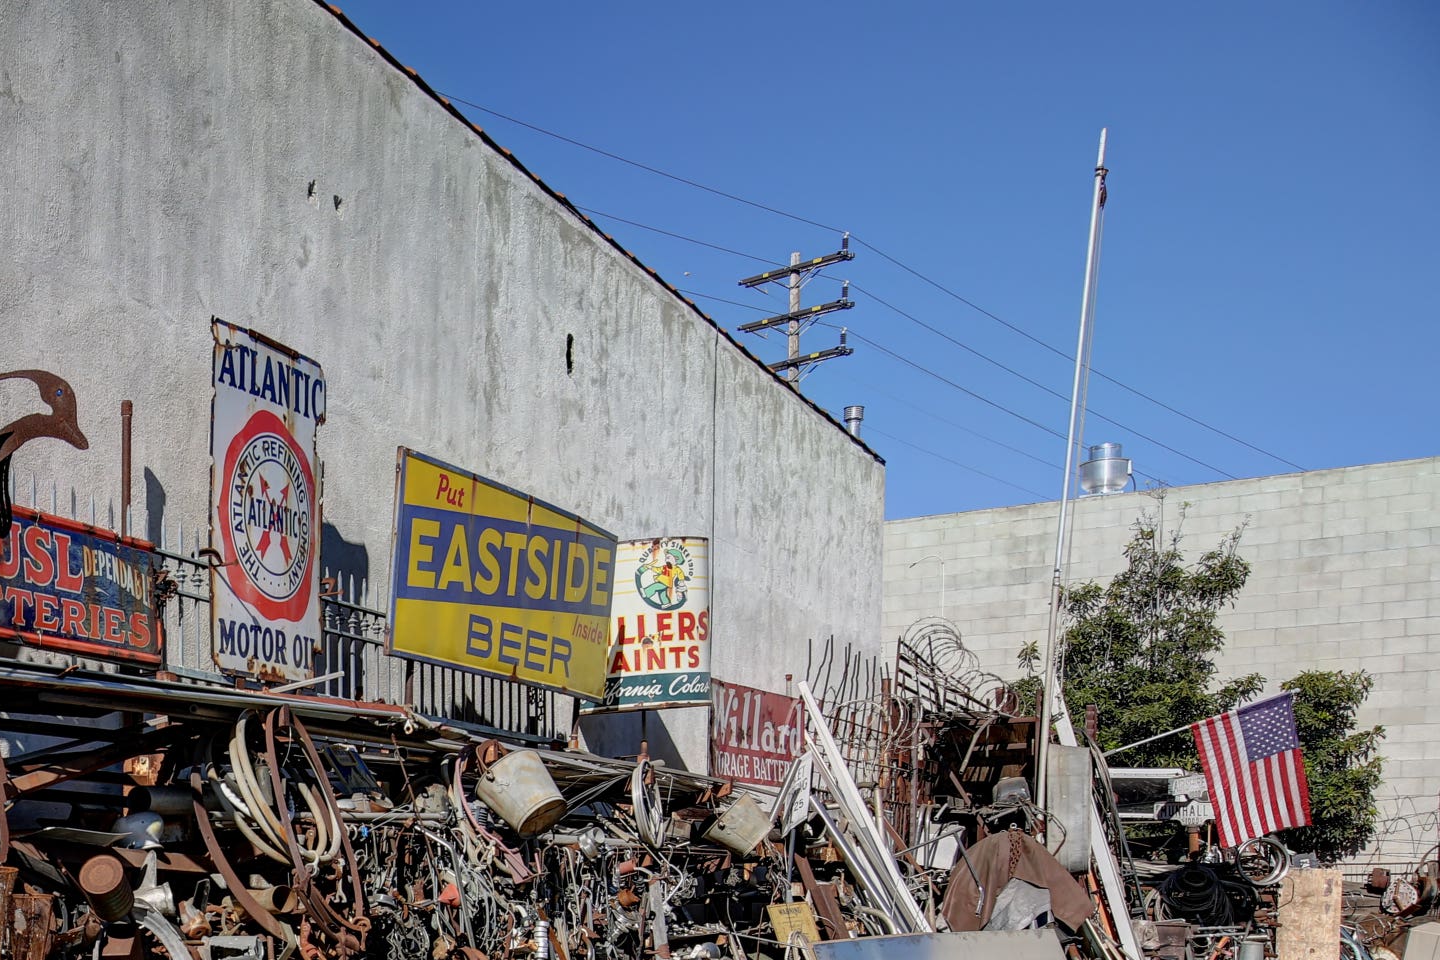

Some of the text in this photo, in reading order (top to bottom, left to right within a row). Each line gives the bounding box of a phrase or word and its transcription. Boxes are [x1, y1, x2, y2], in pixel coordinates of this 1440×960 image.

[218, 339, 323, 422] ATLANTIC
[436, 473, 465, 508] Put
[233, 440, 308, 590] THE ATLANTIC REFINING COMPANY
[248, 497, 298, 538] ATLANTIC
[407, 517, 610, 606] EASTSIDE
[638, 540, 669, 563] QUATY
[670, 541, 690, 558] SINCE
[218, 618, 288, 665] MOTOR
[466, 613, 572, 678] BEER
[572, 615, 603, 645] Inside
[608, 611, 709, 646] LLERS
[610, 646, 700, 673] AINTS
[603, 674, 710, 705] ifornia Colors
[712, 683, 802, 757] Willard
[715, 750, 751, 778] ORAGE
